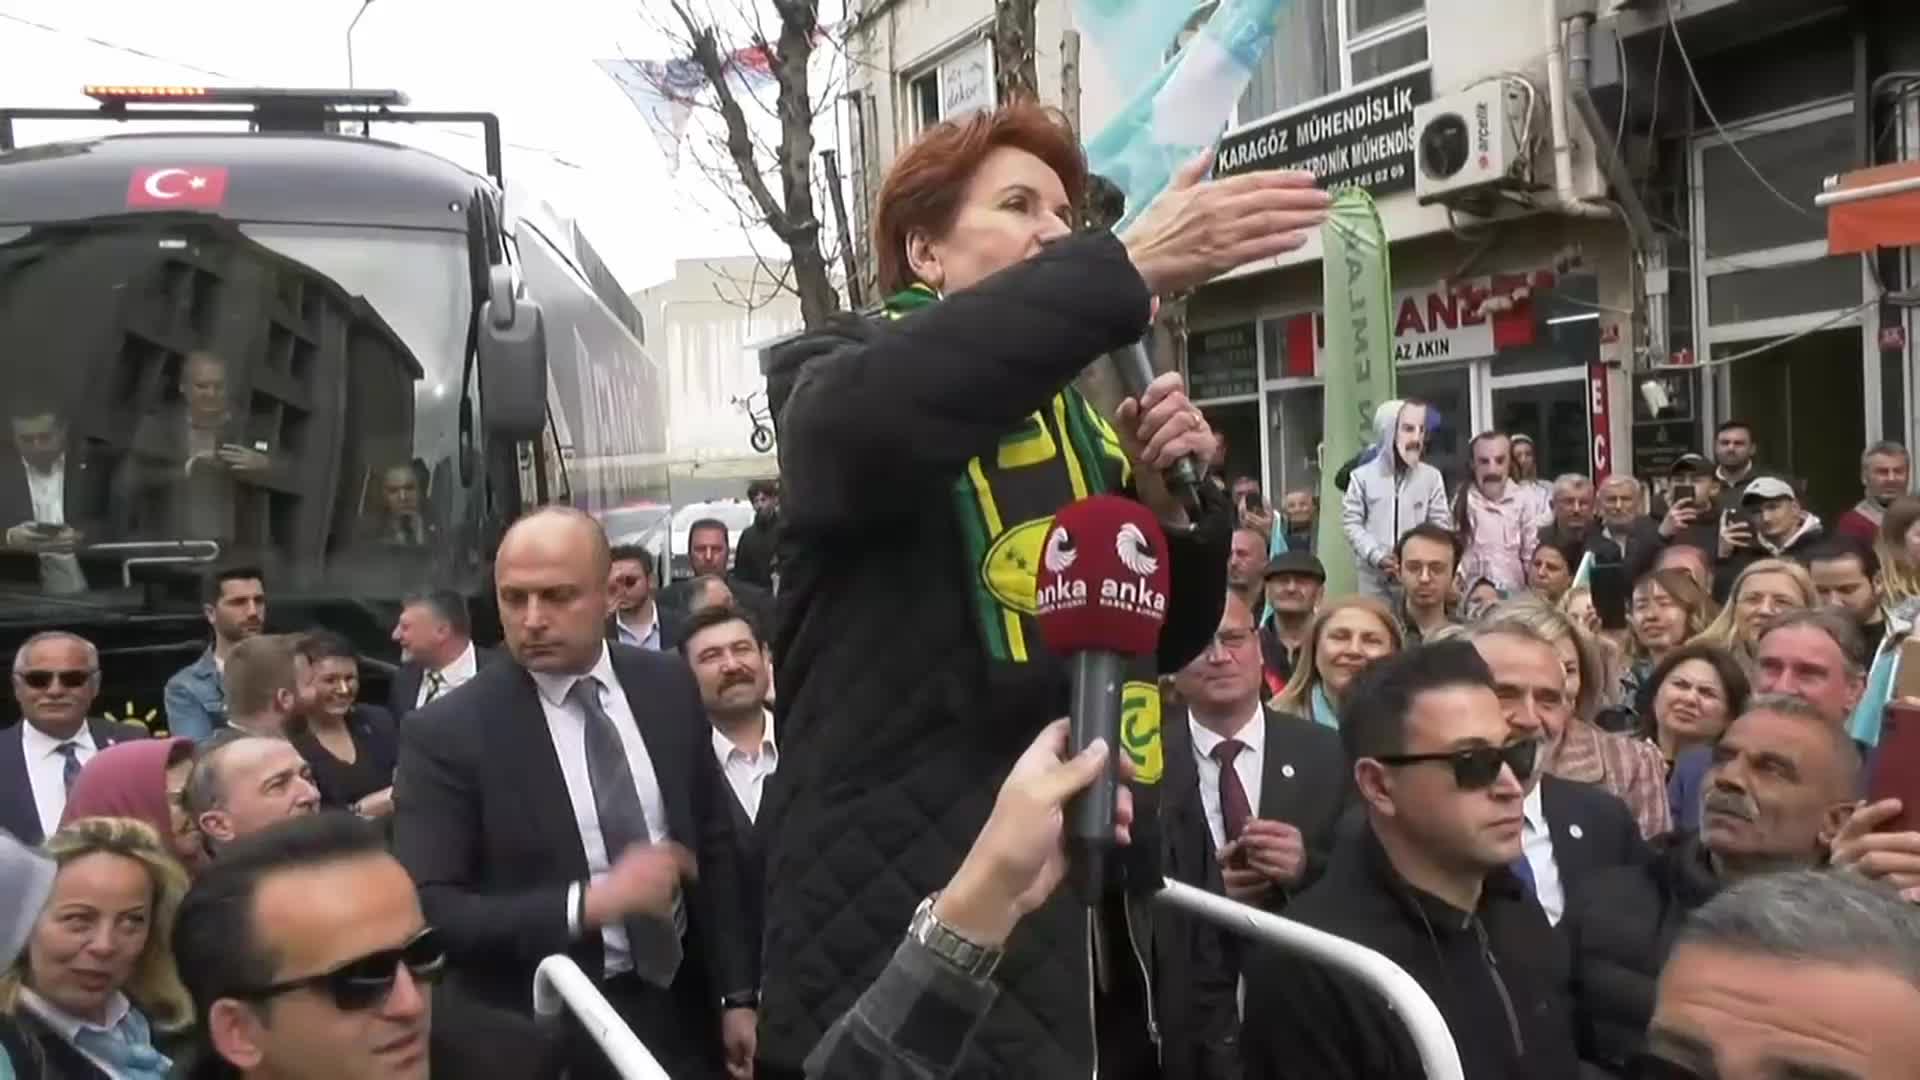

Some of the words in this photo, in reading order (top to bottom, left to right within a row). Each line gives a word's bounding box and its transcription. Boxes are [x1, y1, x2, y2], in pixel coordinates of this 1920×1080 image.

[1218, 127, 1289, 173] KARAGÖZ
[1296, 87, 1412, 147] MÜHENDİSLİK
[1415, 335, 1450, 359] AKIN
[1101, 577, 1165, 611] anka
